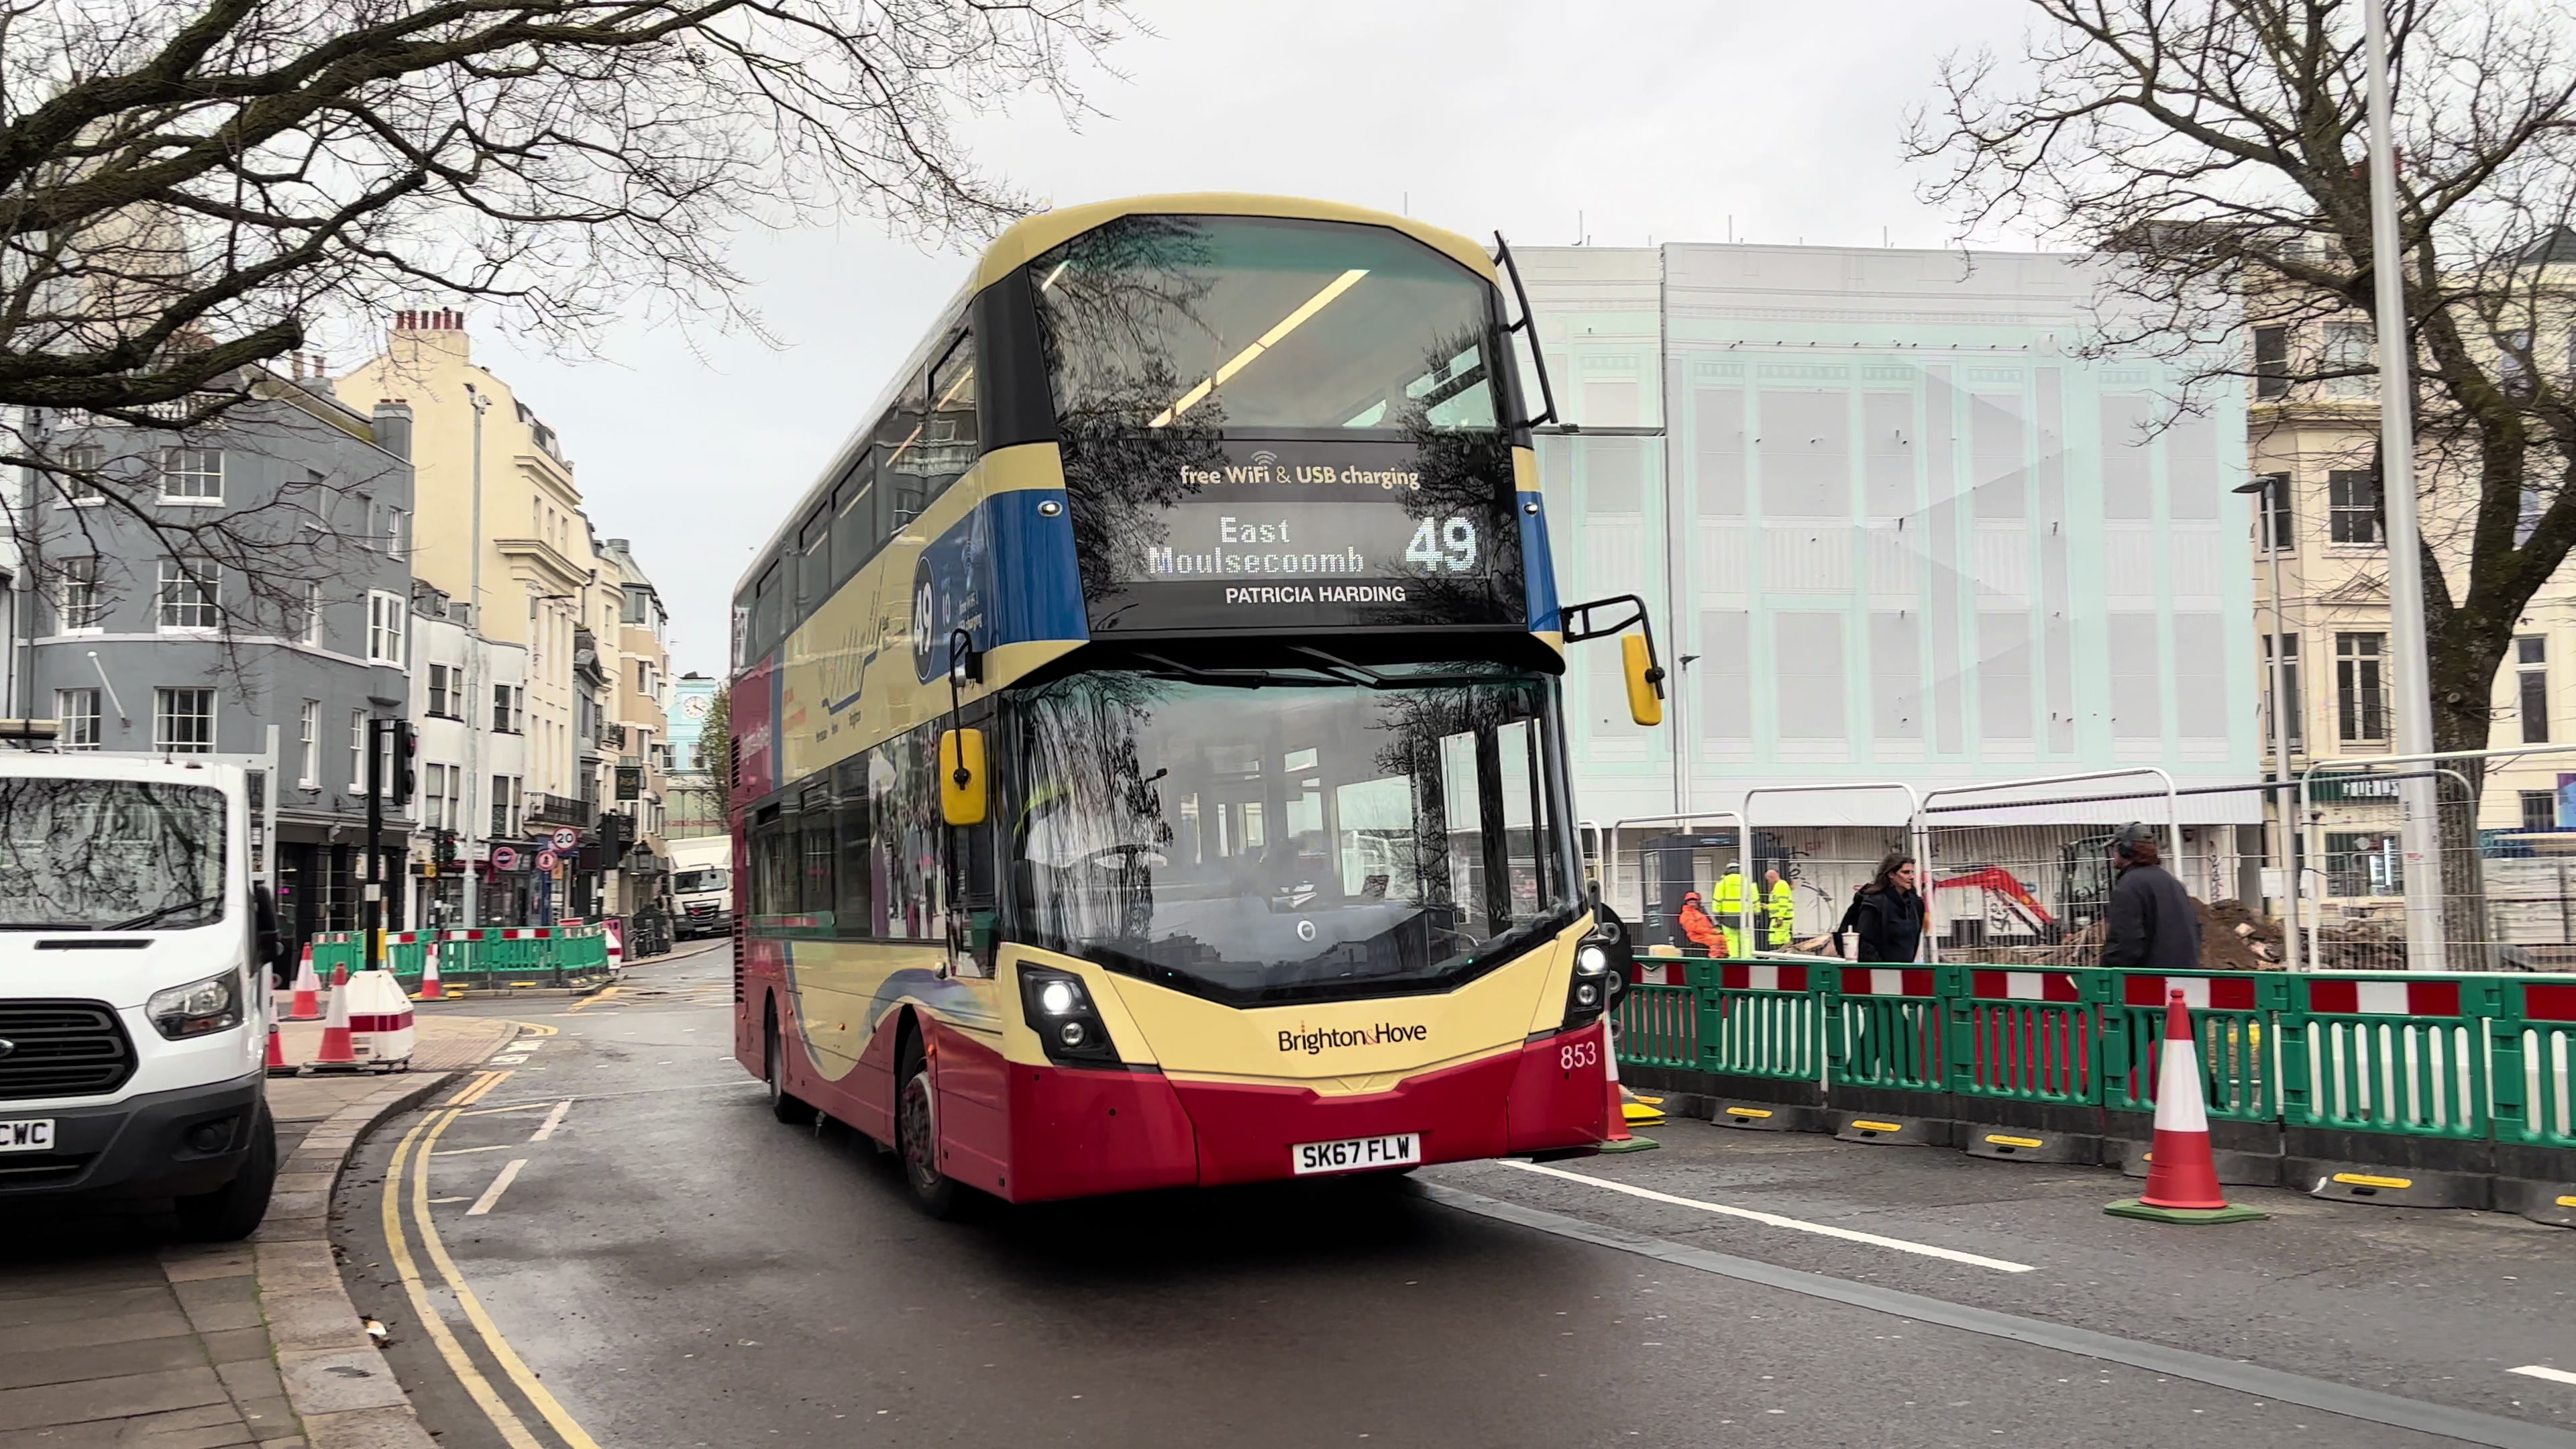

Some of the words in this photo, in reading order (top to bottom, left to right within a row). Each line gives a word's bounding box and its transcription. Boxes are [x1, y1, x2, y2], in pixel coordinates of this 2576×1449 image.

[1181, 465, 1221, 484] free
[1225, 466, 1270, 484] WiFi
[1276, 466, 1291, 484] &
[1296, 466, 1336, 484] USB
[1340, 465, 1420, 490] charging
[1220, 517, 1289, 543] East
[1406, 517, 1477, 572] 49
[1148, 546, 1364, 574] Moulsecoomb
[1226, 588, 1315, 604] PATRICIA
[1319, 586, 1407, 602] HARDING
[914, 582, 933, 655] 49
[557, 833, 574, 843] 20
[1560, 1041, 1597, 1070] 853
[1303, 1142, 1360, 1169] SK67
[1367, 1137, 1409, 1162] FLW
